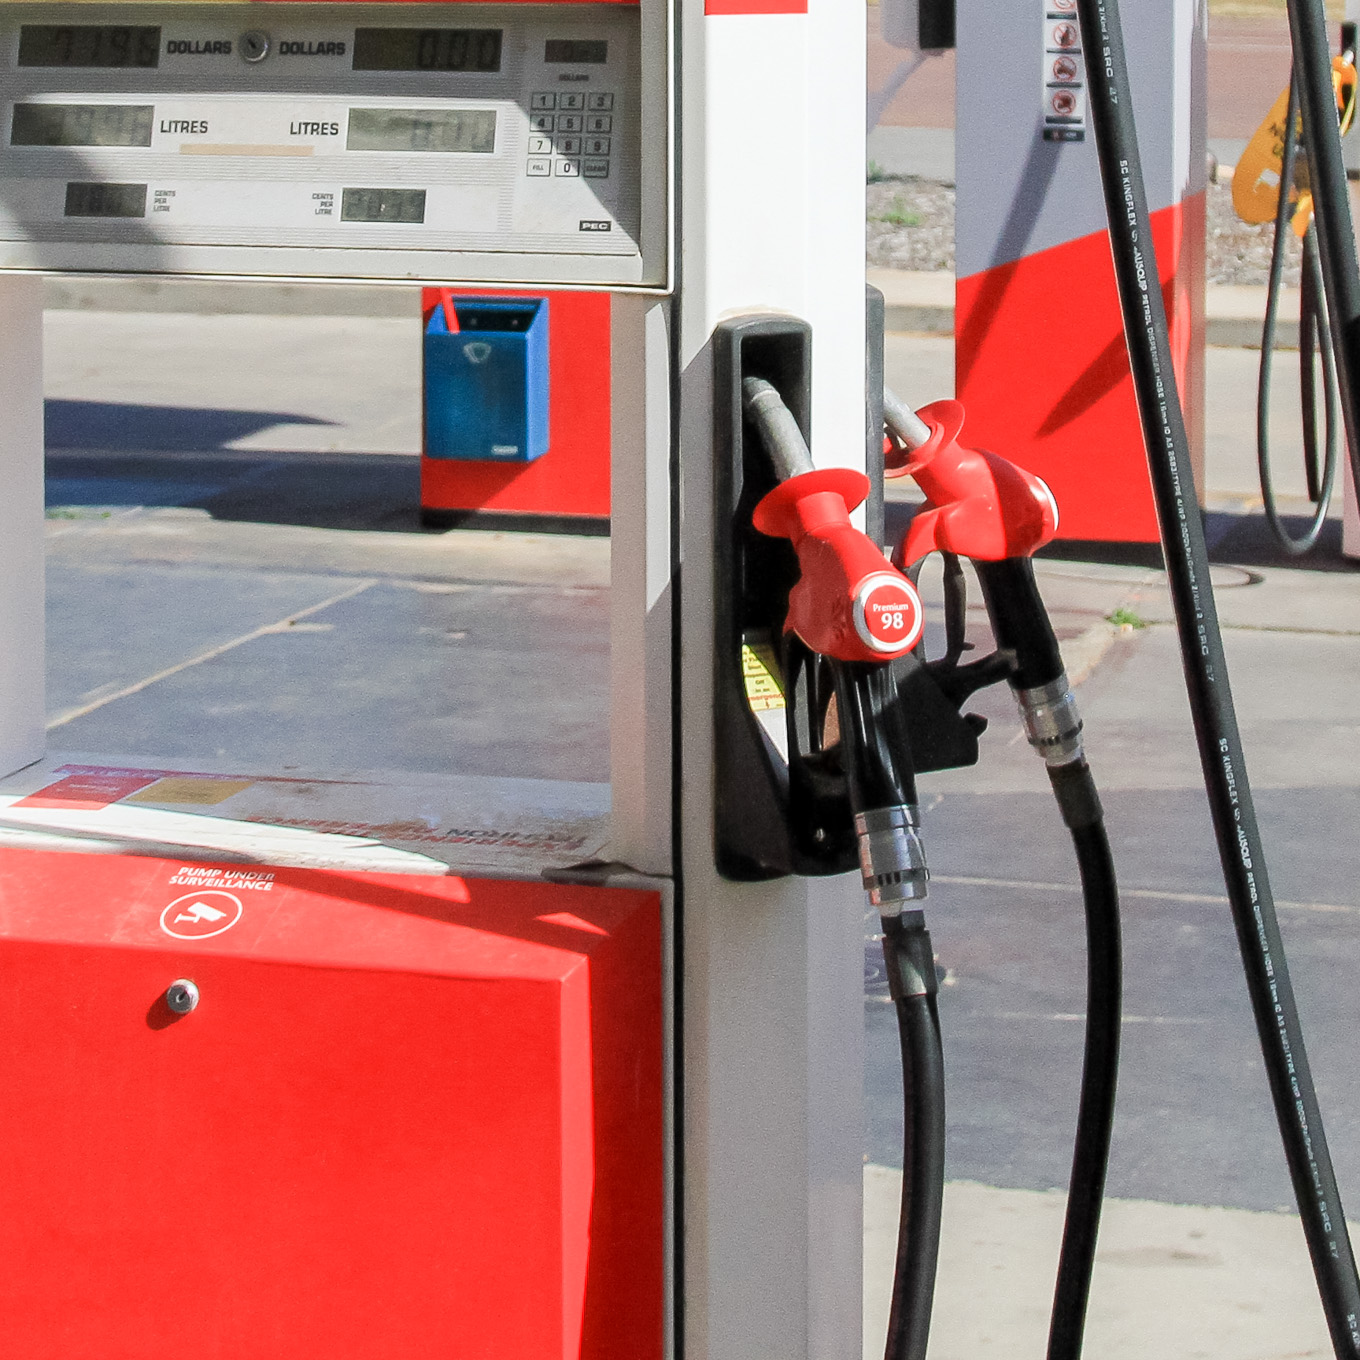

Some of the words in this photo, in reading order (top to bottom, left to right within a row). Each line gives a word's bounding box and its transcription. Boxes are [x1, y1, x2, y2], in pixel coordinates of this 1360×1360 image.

[166, 40, 233, 55] DOLLARS
[279, 41, 346, 56] DOLLARS
[1102, 45, 1115, 78] SRC
[540, 95, 547, 106] 1
[568, 96, 576, 106] 2
[597, 96, 605, 107] 3
[160, 120, 209, 134] LITRES
[290, 122, 339, 136] LITRES
[538, 118, 545, 128] 4
[566, 118, 574, 129] 5
[595, 119, 603, 129] 6
[537, 140, 543, 151] 7
[565, 140, 572, 151] 8
[594, 141, 601, 152] 9
[564, 163, 571, 173] 0
[1118, 159, 1129, 174] SC
[1121, 176, 1137, 226] KINGFLEX
[582, 222, 609, 230] PEC
[1133, 251, 1148, 291] AUSQUIP
[1140, 293, 1152, 325] PETROL
[1154, 375, 1165, 398] HOSE
[1164, 436, 1173, 449] AS
[873, 602, 909, 612] Premium
[881, 612, 904, 630] 98
[1217, 737, 1228, 752] SC
[1220, 754, 1239, 804] KINGFLEX
[1236, 829, 1252, 869] AUSQUIP
[178, 867, 223, 878] PUMP
[224, 870, 276, 881] UNDER
[169, 875, 274, 891] SURVEILLANCE
[1244, 870, 1258, 903] PETROL
